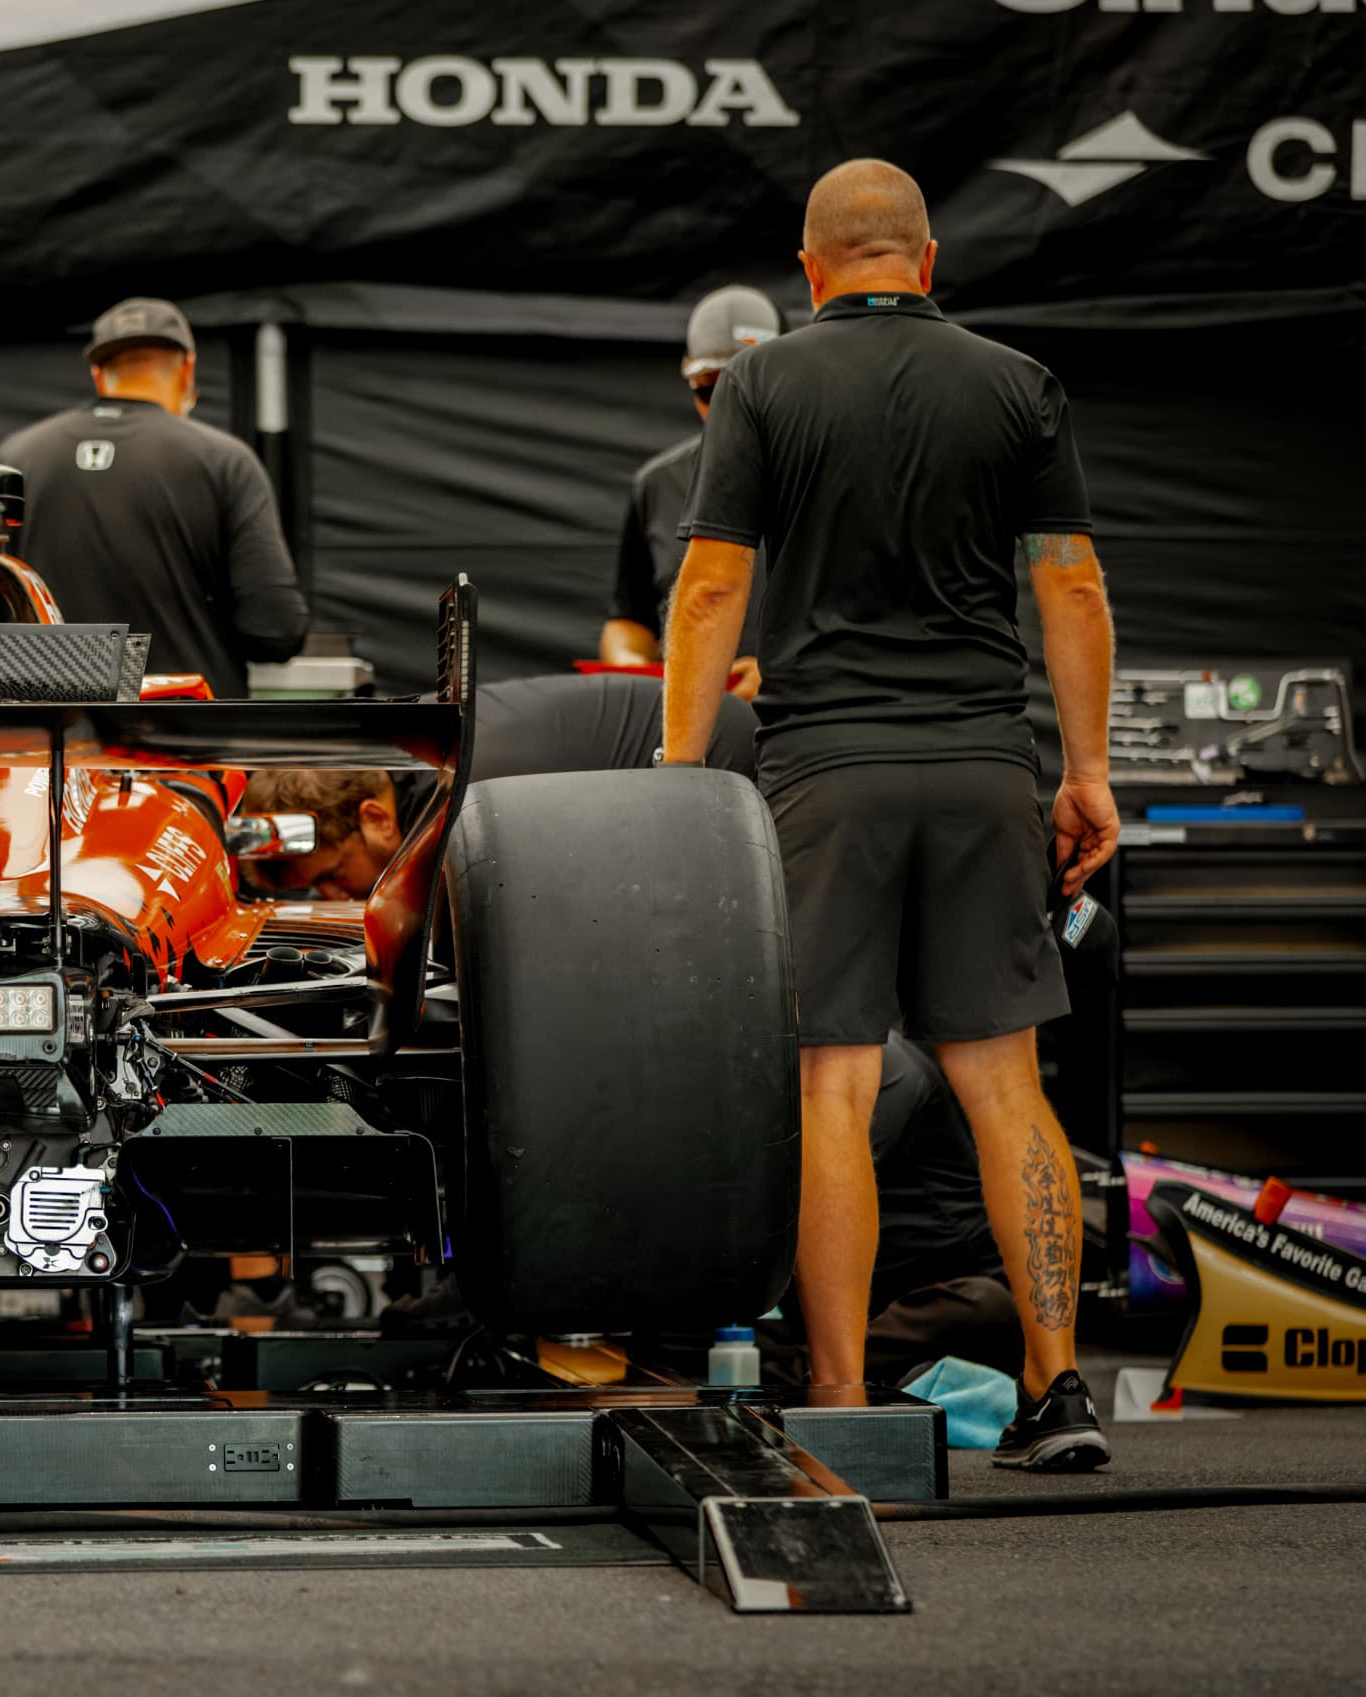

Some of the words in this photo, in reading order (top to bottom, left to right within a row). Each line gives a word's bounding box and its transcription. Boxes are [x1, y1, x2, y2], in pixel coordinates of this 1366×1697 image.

[288, 56, 800, 127] HONDA
[1183, 1192, 1270, 1249] America's
[1270, 1232, 1343, 1282] Favorite
